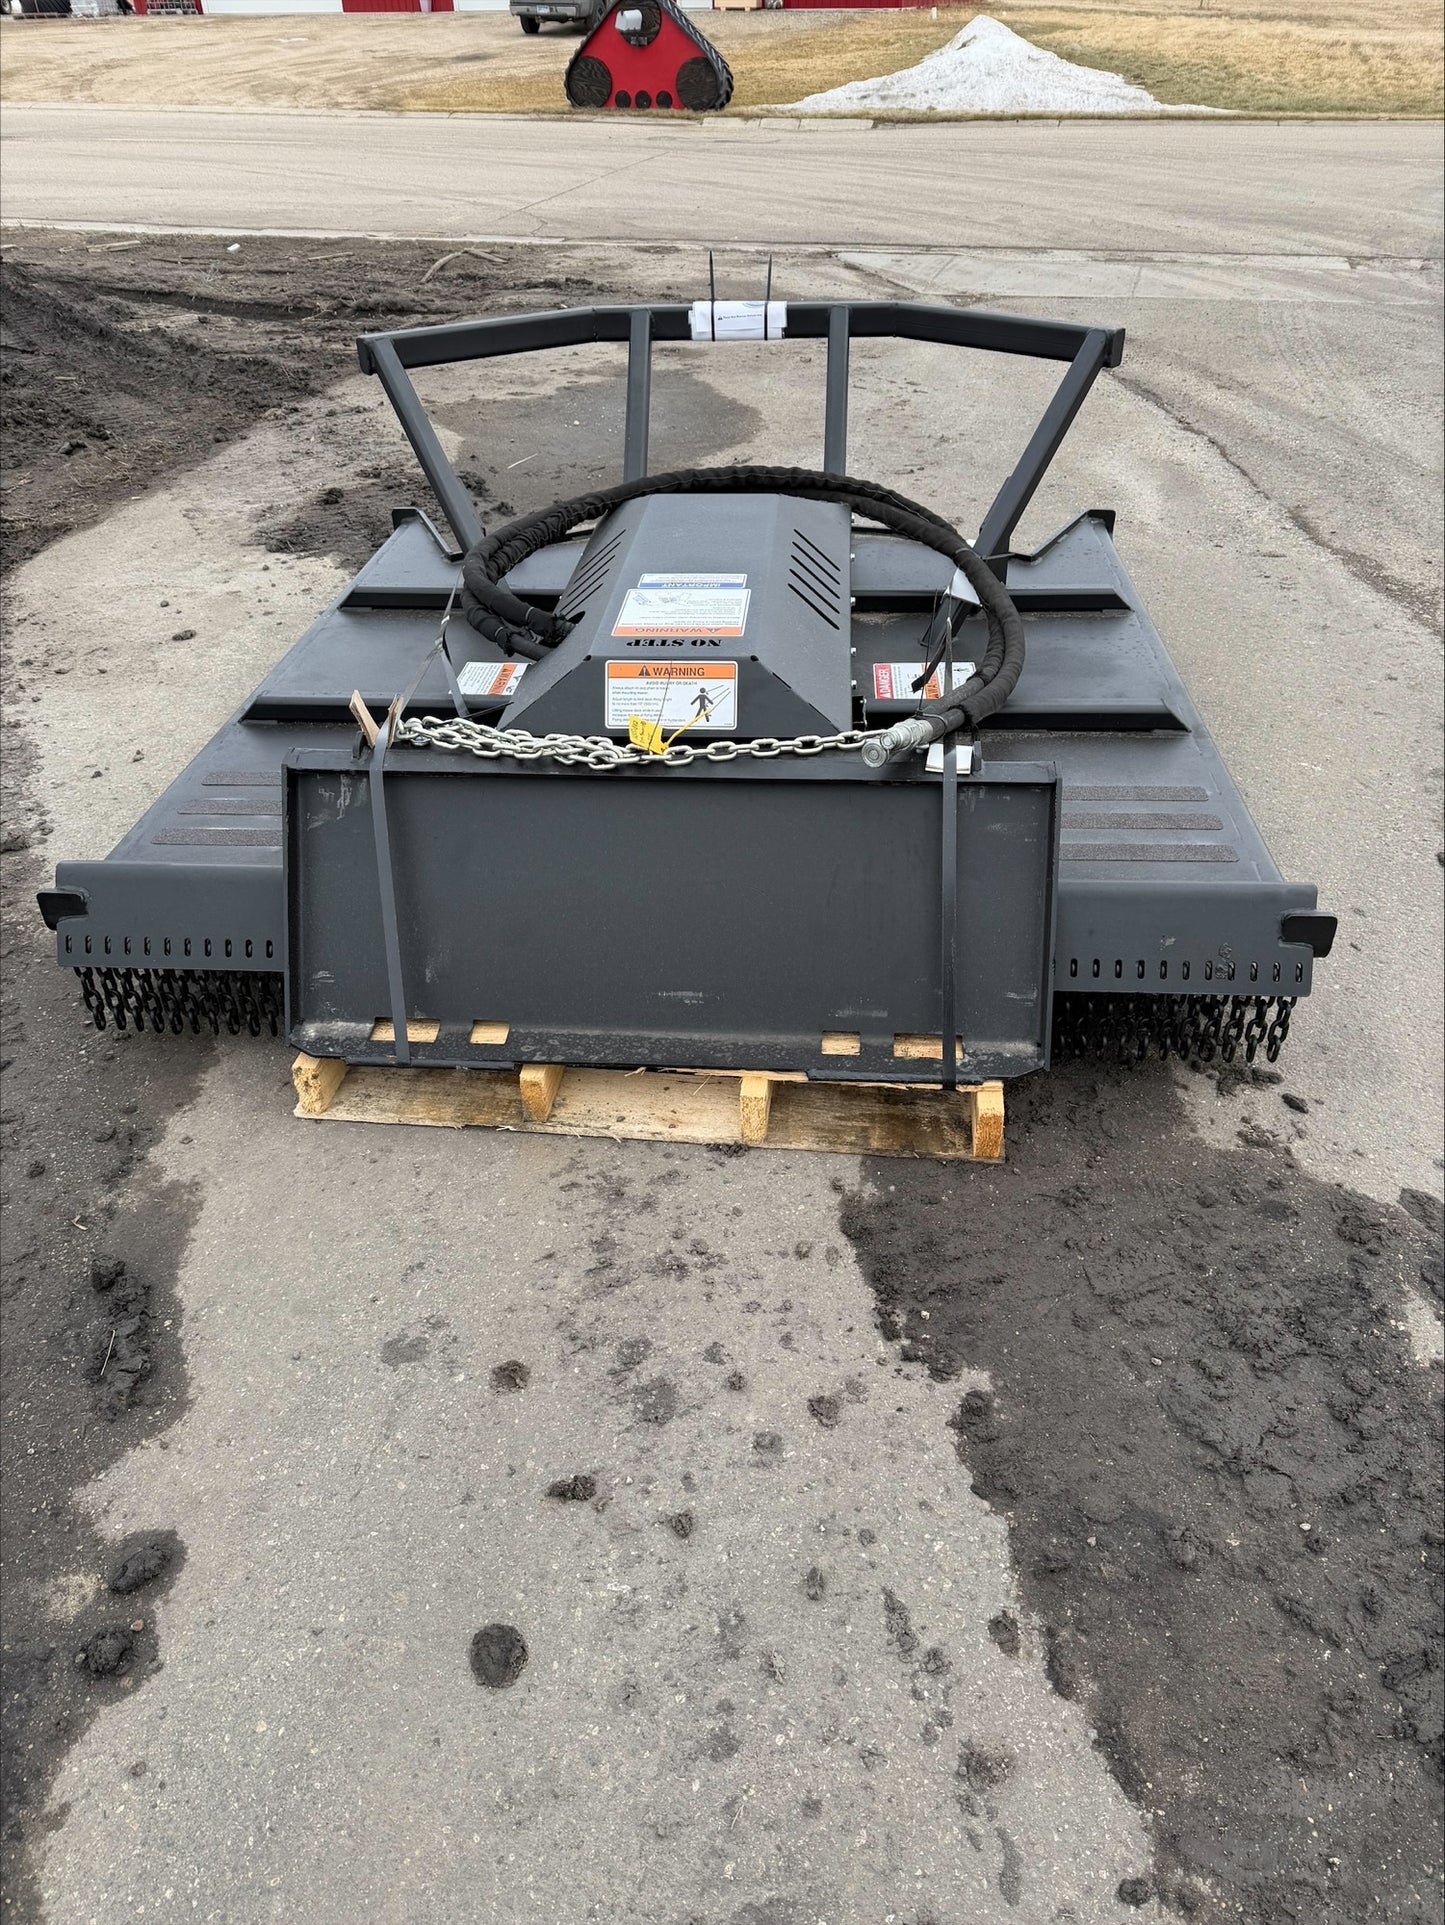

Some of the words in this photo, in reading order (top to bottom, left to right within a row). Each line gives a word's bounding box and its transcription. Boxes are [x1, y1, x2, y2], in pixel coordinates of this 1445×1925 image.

[626, 638, 685, 647] STEP
[691, 638, 721, 647] NO
[653, 667, 705, 677] WARNING
[878, 669, 890, 693] DANGER
